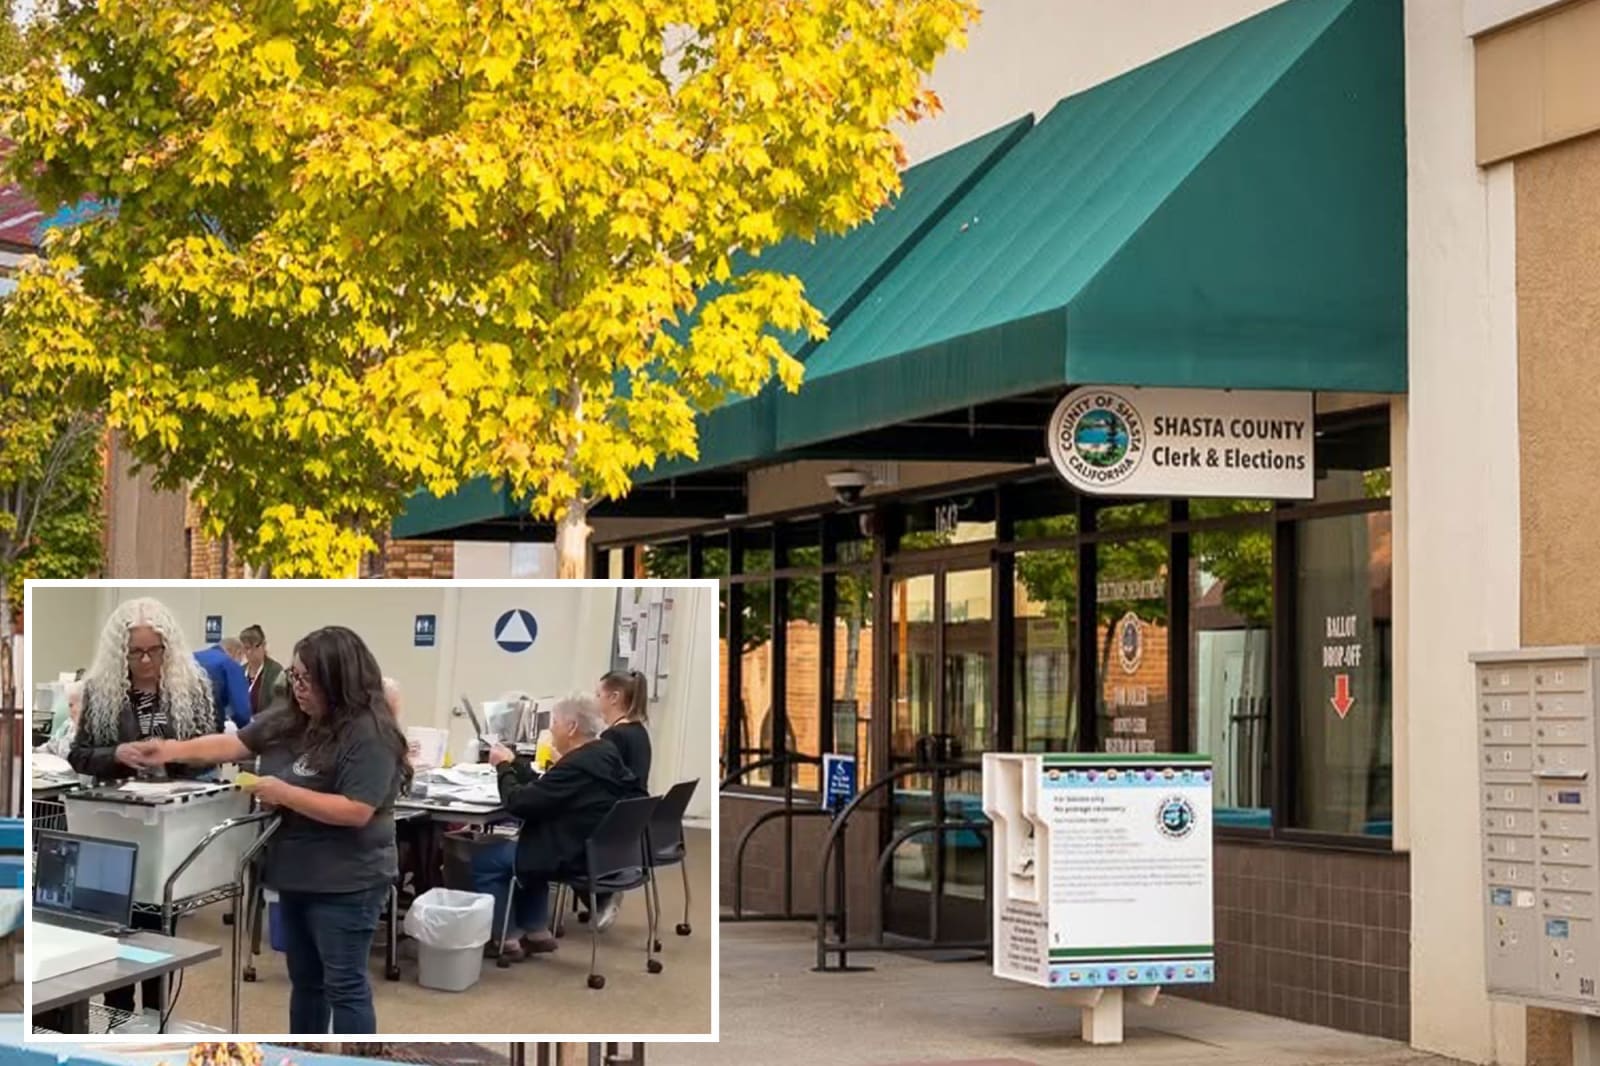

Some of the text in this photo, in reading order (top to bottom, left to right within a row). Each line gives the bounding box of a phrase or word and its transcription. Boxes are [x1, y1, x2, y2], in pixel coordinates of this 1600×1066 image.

[1060, 395, 1142, 452] COUNTY OF SHASTA
[1153, 416, 1305, 440] SHASTA COUNTY
[1068, 455, 1134, 482] CALIFORNIA
[1152, 446, 1305, 470] Clerk & Elections
[1326, 615, 1357, 638] BALLOT
